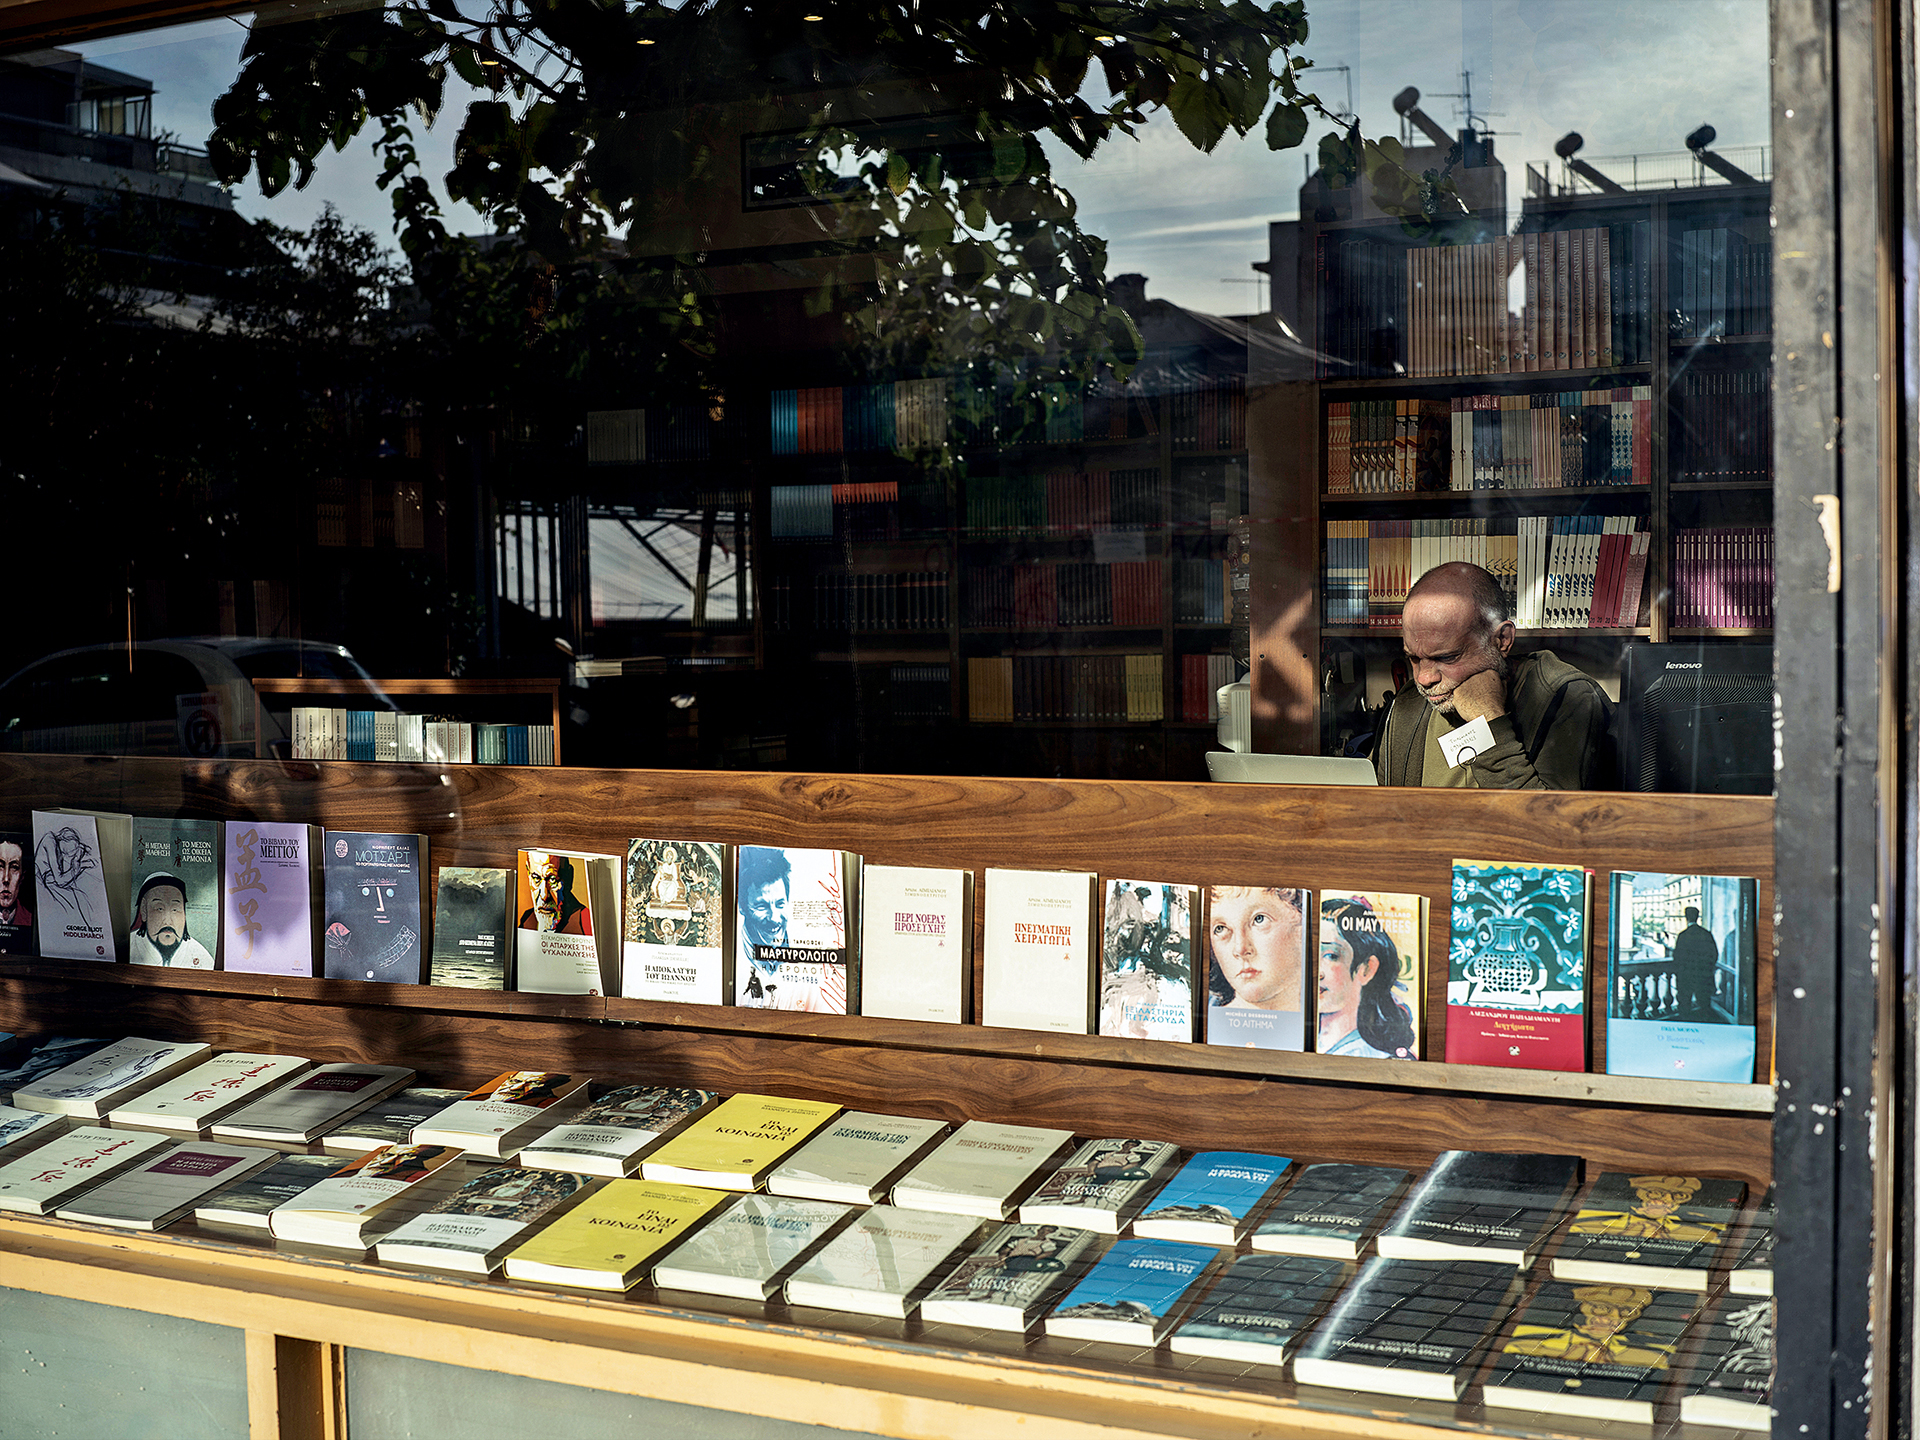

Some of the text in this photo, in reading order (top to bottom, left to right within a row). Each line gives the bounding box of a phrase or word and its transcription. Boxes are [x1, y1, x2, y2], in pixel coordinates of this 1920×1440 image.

[260, 846, 300, 858] ΜΕΓΓΙΟΥ
[356, 850, 410, 863] ΜΟΤΣΑΡΤ
[895, 913, 946, 924] ΠΕΡΙ ΝΟΕΡΑΣ
[895, 922, 946, 933] ΠΡΟΣΕΥΧΗΣ
[1015, 923, 1071, 935] ΠΝΕΥΜΑΤΙΚΗ
[1015, 933, 1071, 946] ΧΕΙΡΑΓΩΓΙΑ
[542, 949, 596, 958] ΨΥΧΑΝΑΛΥΣΗΣ
[760, 948, 837, 963] ΜΑΡΤΥΡΟΛΟΓΙΟ
[651, 966, 696, 974] ΑΠΟΚΑΛΥΨΗ
[762, 965, 837, 975] ΗΜΕΡΟΛΟΓΙΑ
[661, 974, 696, 982] ΙΩΑΝΝΟΥ
[1126, 1006, 1185, 1016] ΕΞΙΛΑΣΤΗΡΙΑ
[1126, 1014, 1185, 1024] ΠΕΤΑΛΟΥΔΑ
[1469, 1011, 1560, 1023] ΑΛΕΞΑΝΔΡΟΥ ΠΑΠΑΔΙΑΜΑΝΤΗ
[1229, 1018, 1274, 1029] ΤΟ ΑΙΤΗΜΑ
[716, 1127, 788, 1141] ΚΟΙΝΩΝΙΑ
[760, 1124, 798, 1133] ΕΙΝΑΙ
[638, 1213, 679, 1225] ΕΙΝΑΙ
[588, 1218, 664, 1234] ΚΟΙΝΩΝΙΑ
